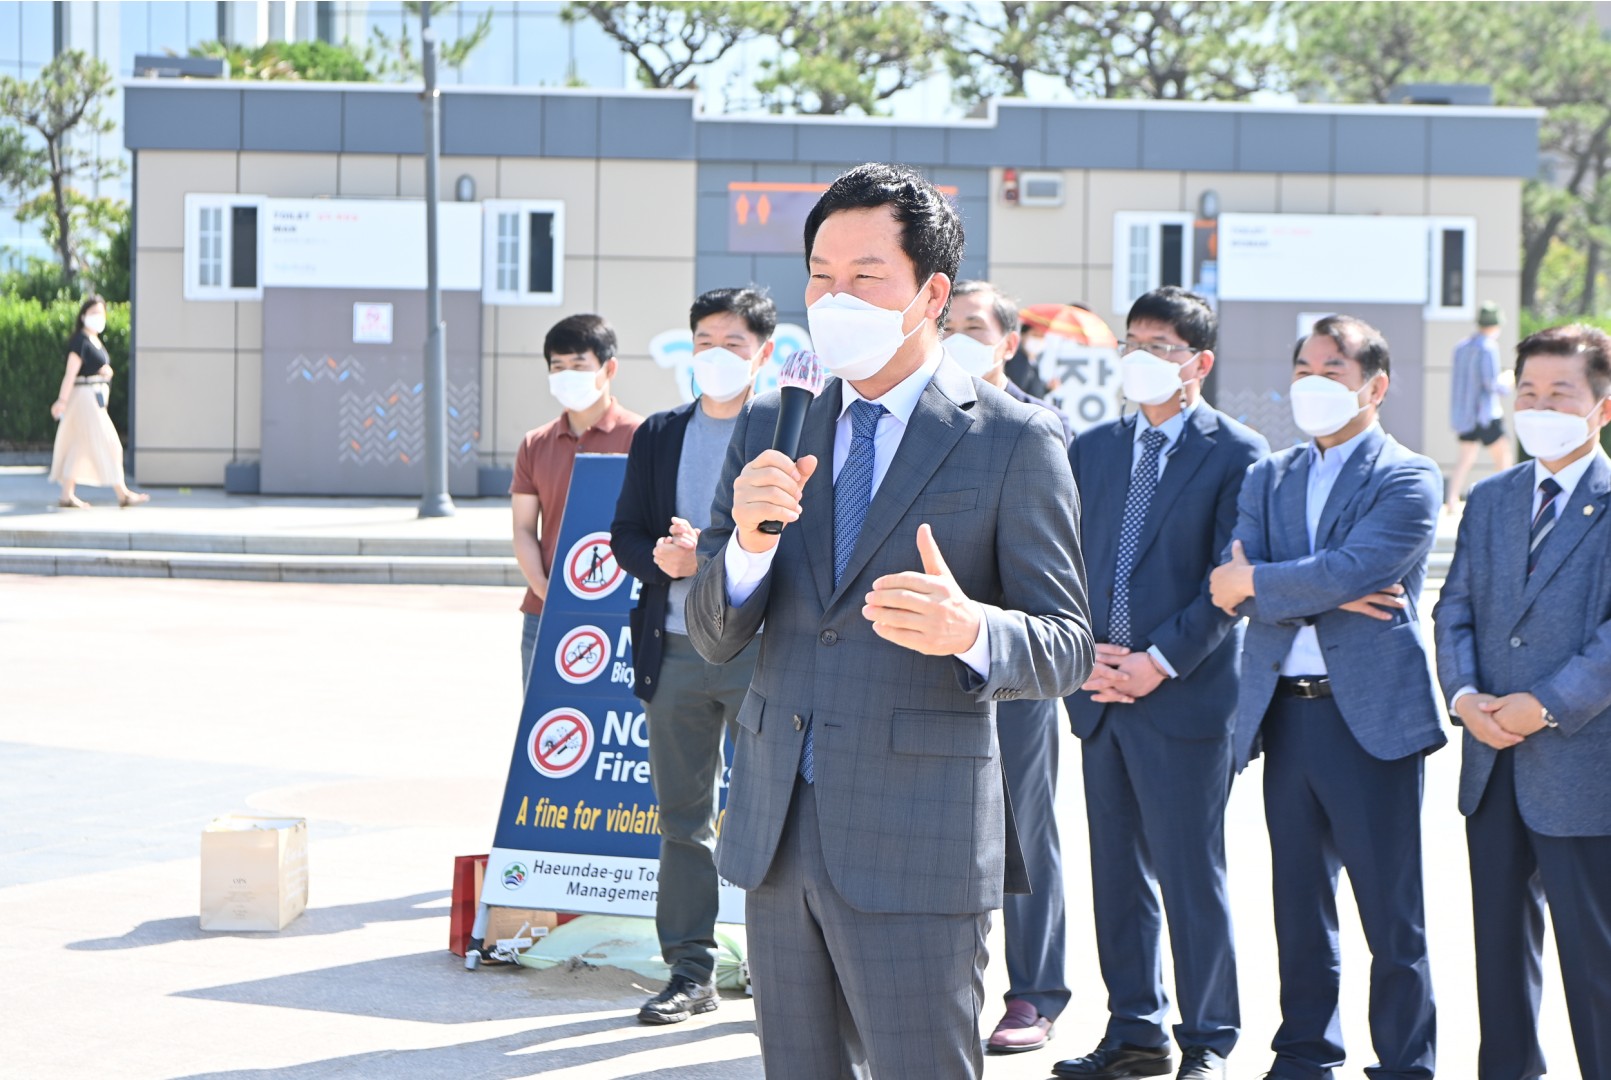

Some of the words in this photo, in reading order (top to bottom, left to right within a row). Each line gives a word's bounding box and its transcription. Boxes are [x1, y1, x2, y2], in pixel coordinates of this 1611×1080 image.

[1055, 358, 1114, 423] 장
[514, 795, 529, 826] A
[533, 797, 569, 829] fine
[573, 800, 602, 831] for
[533, 859, 634, 884] Haeundae-gu
